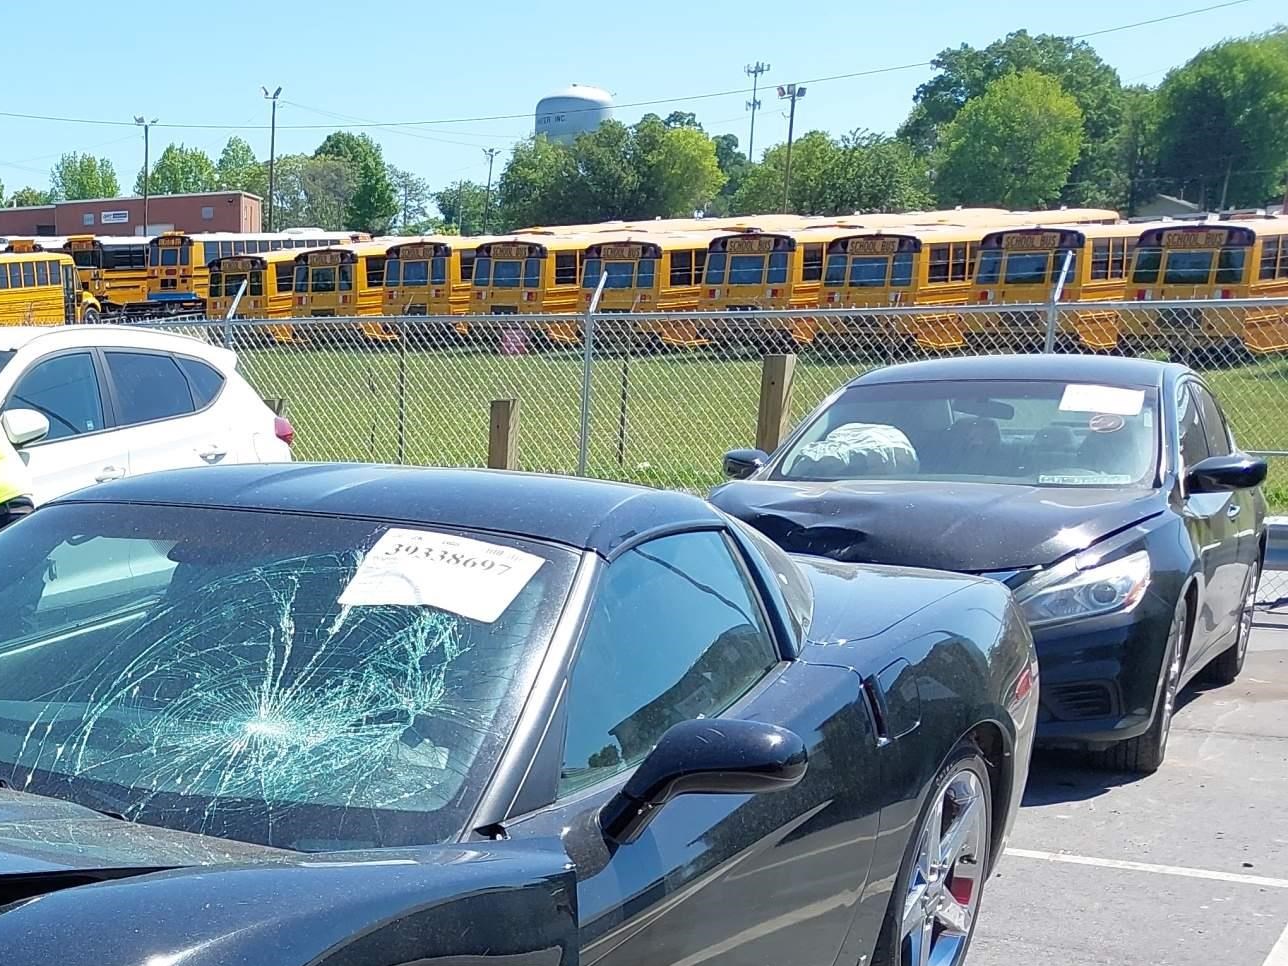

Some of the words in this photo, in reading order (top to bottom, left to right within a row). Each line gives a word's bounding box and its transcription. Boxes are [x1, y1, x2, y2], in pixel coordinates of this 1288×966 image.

[729, 240, 754, 251] SCHOOL
[758, 239, 772, 249] BUS
[850, 240, 877, 252] SCHOOL
[881, 240, 897, 251] BUS
[1007, 235, 1037, 248] SCHOOL
[1040, 234, 1056, 246] BUS
[1167, 232, 1200, 247] SCHOOL
[1207, 231, 1224, 244] BUS
[385, 543, 512, 576] 39338697
